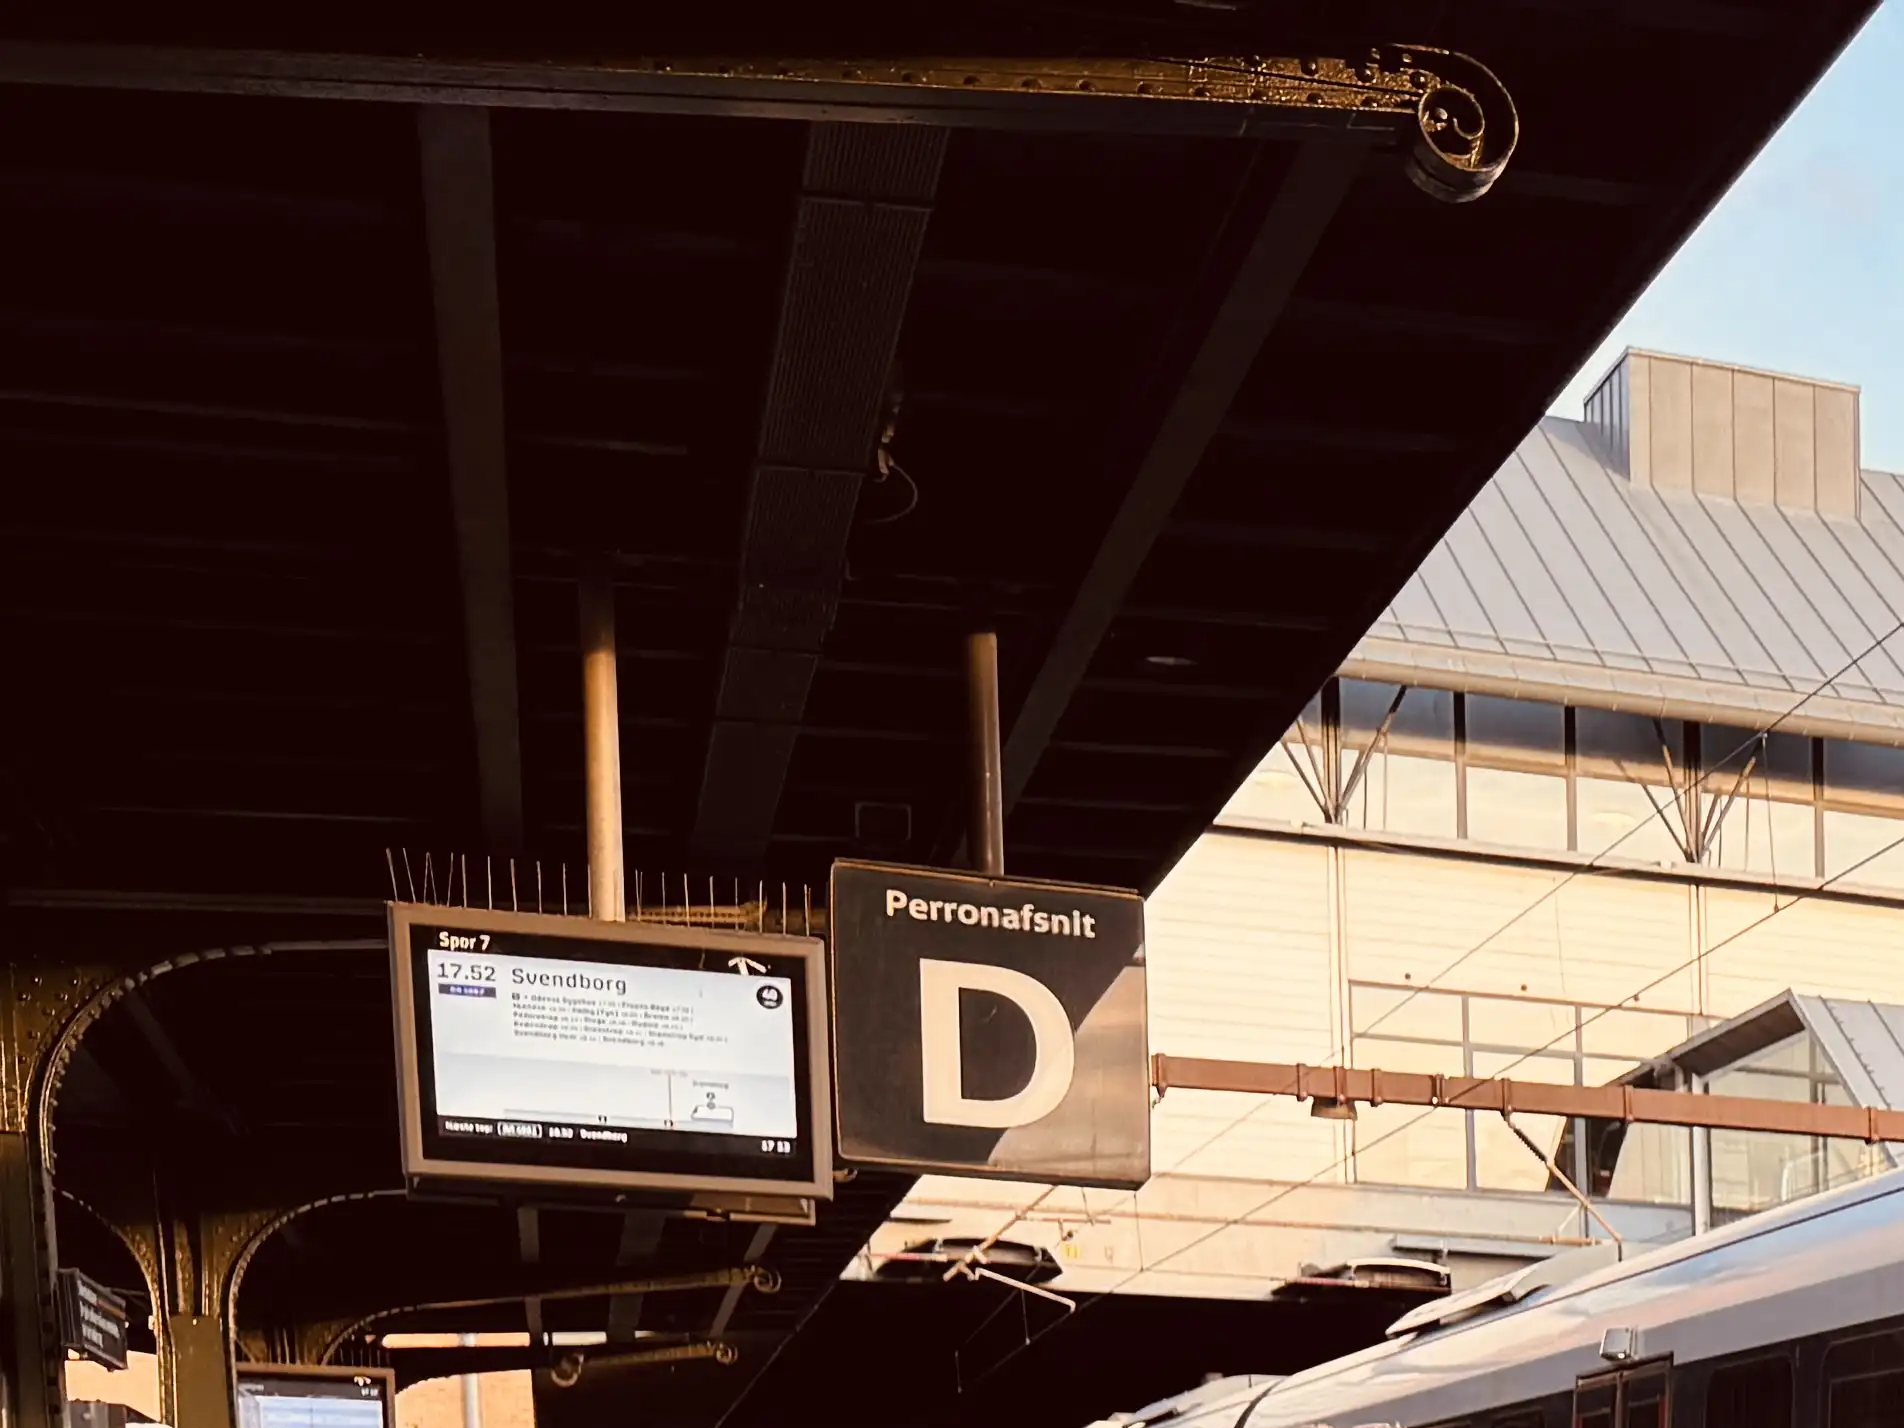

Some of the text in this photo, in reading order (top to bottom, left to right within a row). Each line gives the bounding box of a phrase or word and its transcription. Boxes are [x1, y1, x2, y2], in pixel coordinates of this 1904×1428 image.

[885, 888, 1097, 939] Perronafsnit
[439, 931, 491, 951] Spor 7
[437, 962, 497, 982] 17.52
[511, 968, 627, 995] Svendborg
[919, 957, 1076, 1130] D
